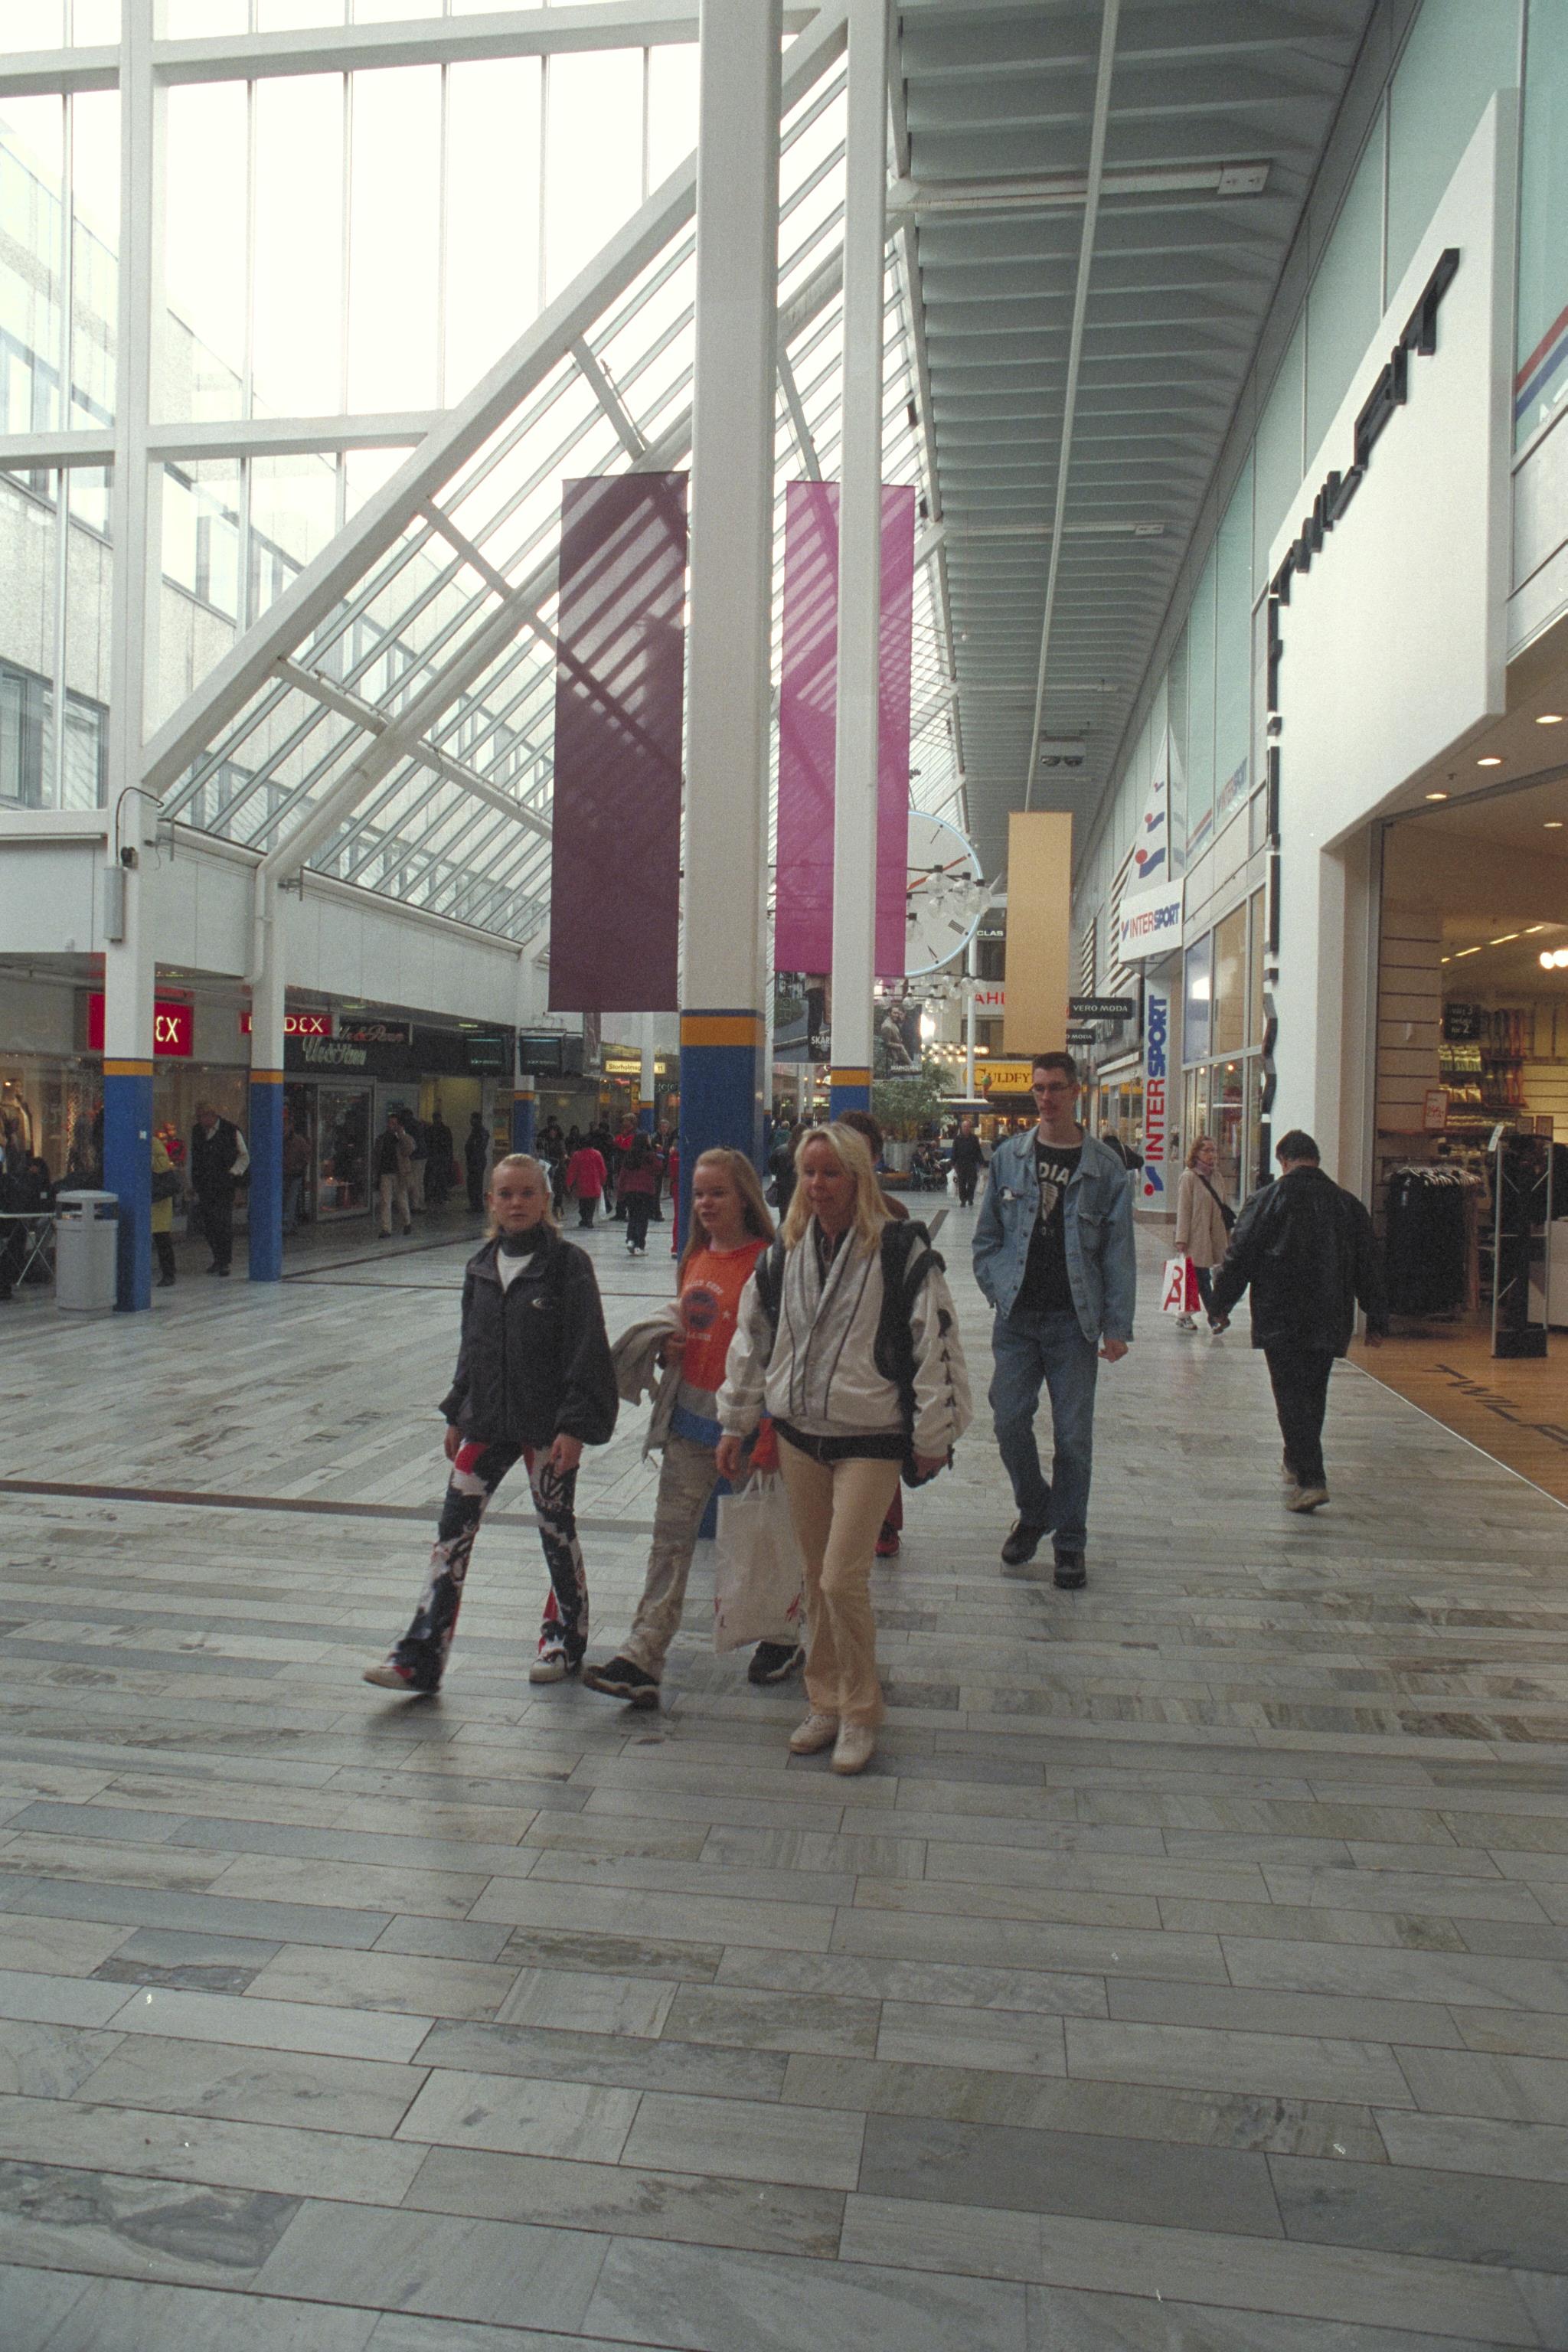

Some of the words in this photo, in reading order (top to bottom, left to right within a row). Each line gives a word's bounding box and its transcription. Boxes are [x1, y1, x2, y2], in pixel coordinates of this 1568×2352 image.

[1129, 902, 1181, 939] INTERSPORT
[976, 929, 1004, 937] CLAS
[1073, 1004, 1098, 1012] VERO
[1099, 1004, 1128, 1012] MODA
[247, 1014, 324, 1033] LDEX
[972, 1067, 1031, 1086] GULDFY
[1145, 994, 1168, 1161] INTERSPORT
